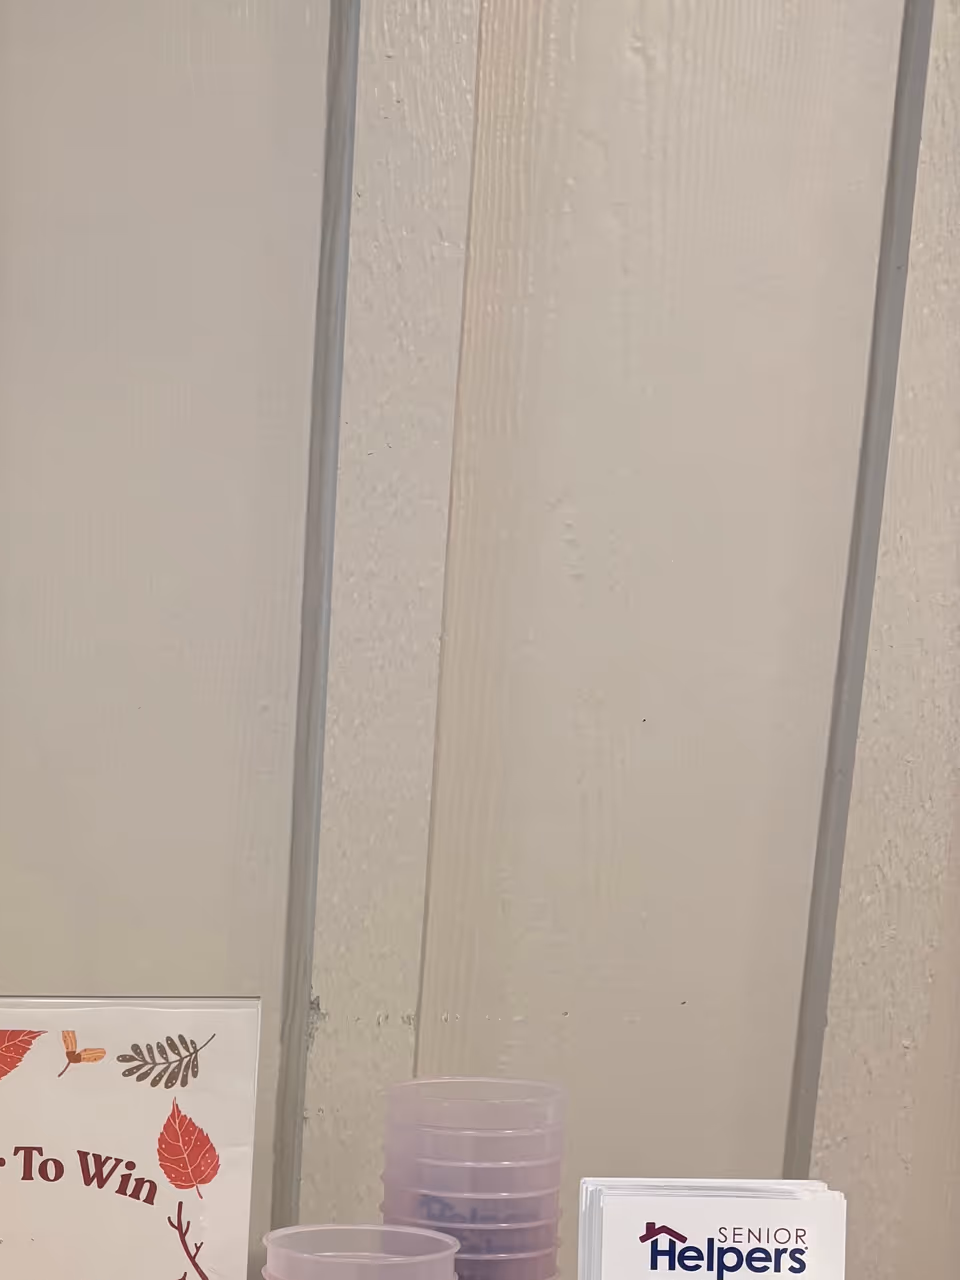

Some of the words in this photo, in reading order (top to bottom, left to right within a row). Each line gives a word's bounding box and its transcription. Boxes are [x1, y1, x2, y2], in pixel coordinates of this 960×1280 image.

[13, 1146, 65, 1182] To
[76, 1149, 158, 1206] Win
[718, 1227, 807, 1244] SENIOR
[650, 1238, 807, 1280] Helpers
